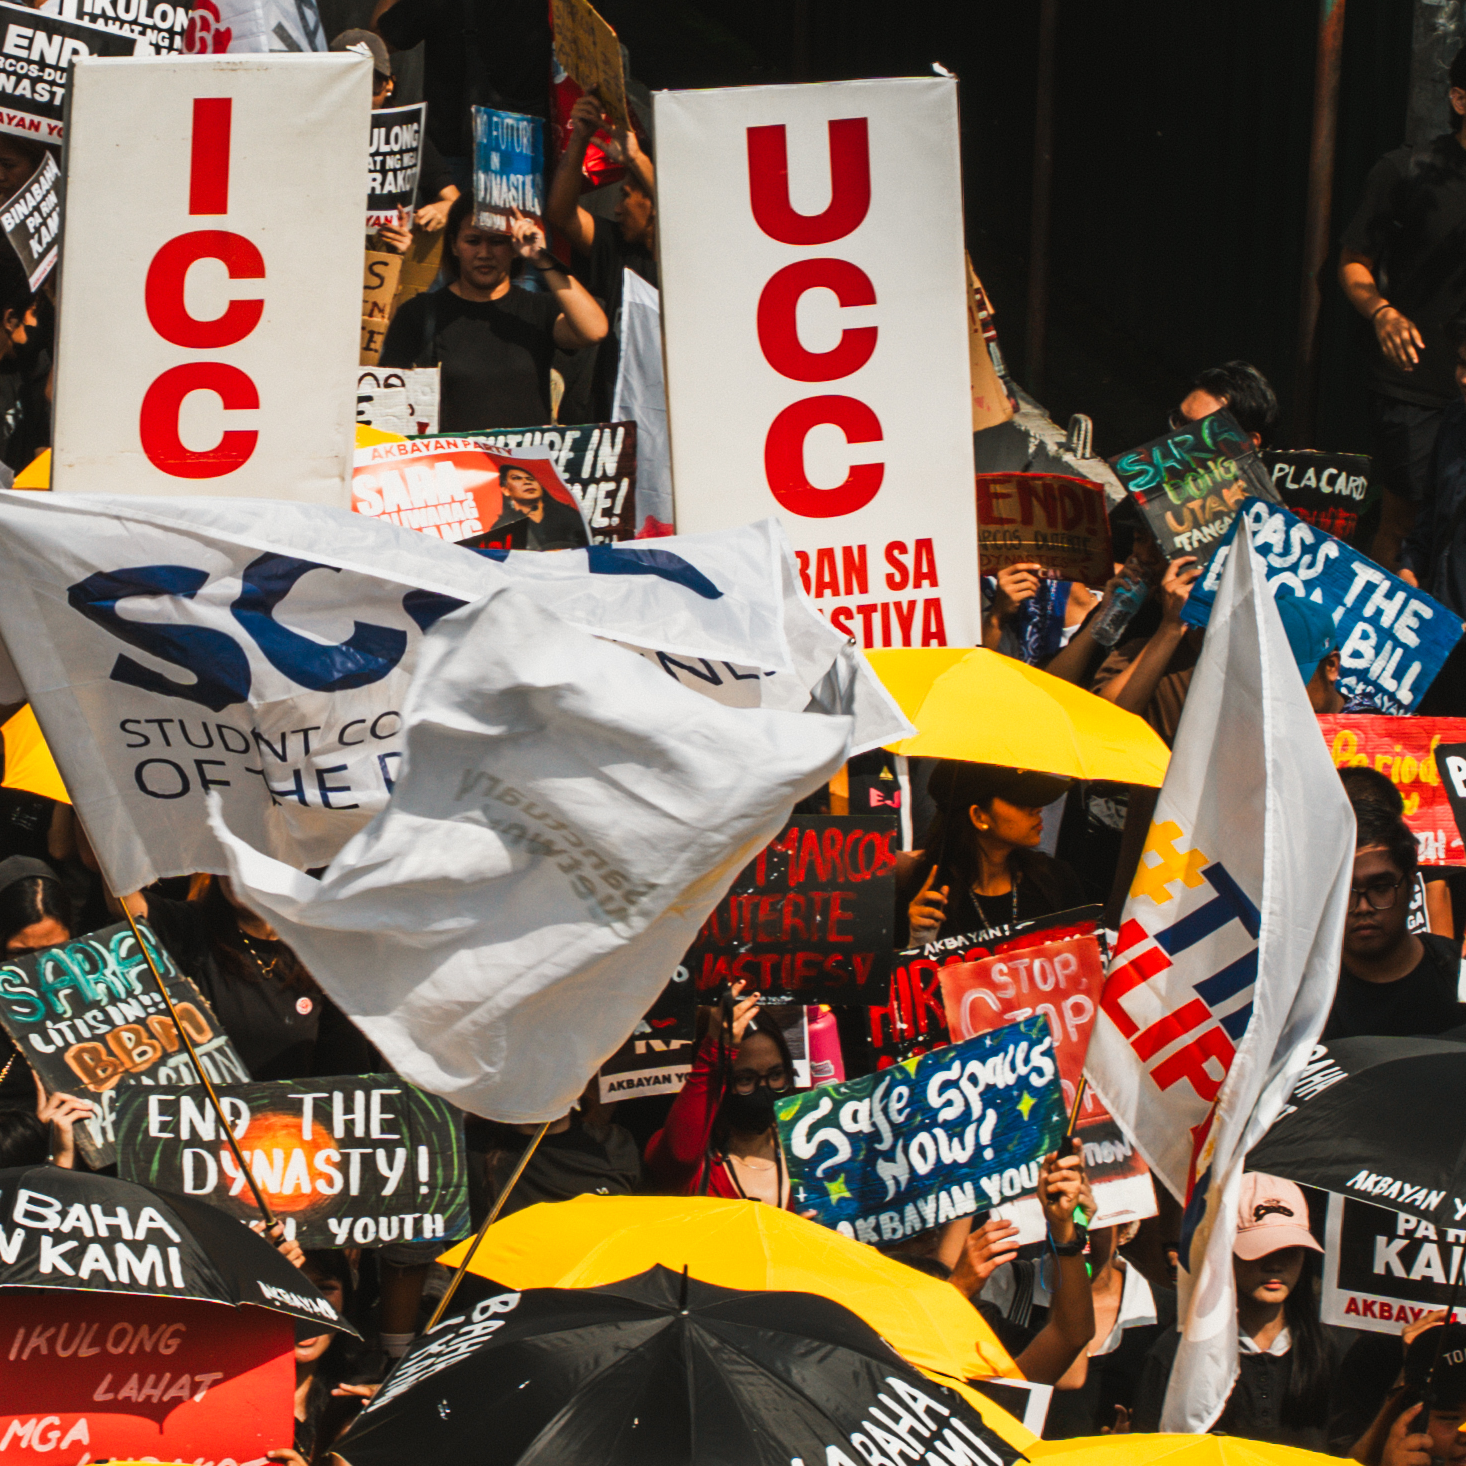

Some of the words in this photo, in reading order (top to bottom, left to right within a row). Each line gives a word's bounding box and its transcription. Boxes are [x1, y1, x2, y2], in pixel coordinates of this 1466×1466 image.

[139, 98, 267, 480] ICC
[746, 116, 885, 518] UCC
[371, 439, 460, 462] AKBAYAN
[1116, 416, 1247, 493] SARA
[1271, 462, 1369, 501] PLACARD
[885, 536, 939, 591] SA
[1341, 560, 1435, 649] THE
[607, 1072, 673, 1094] AKBAYAN
[148, 1092, 252, 1143] END
[287, 1088, 404, 1141] THE
[791, 1073, 912, 1178] Safe
[181, 1145, 432, 1198] DYNASTY!
[1346, 1167, 1446, 1213] AKBAYAN
[12, 1187, 182, 1245] BAHA
[328, 1212, 446, 1248] YOUTH
[36, 1236, 187, 1291] KAMI
[7, 1321, 189, 1361] IKULONG
[92, 1371, 225, 1404] LAHAT
